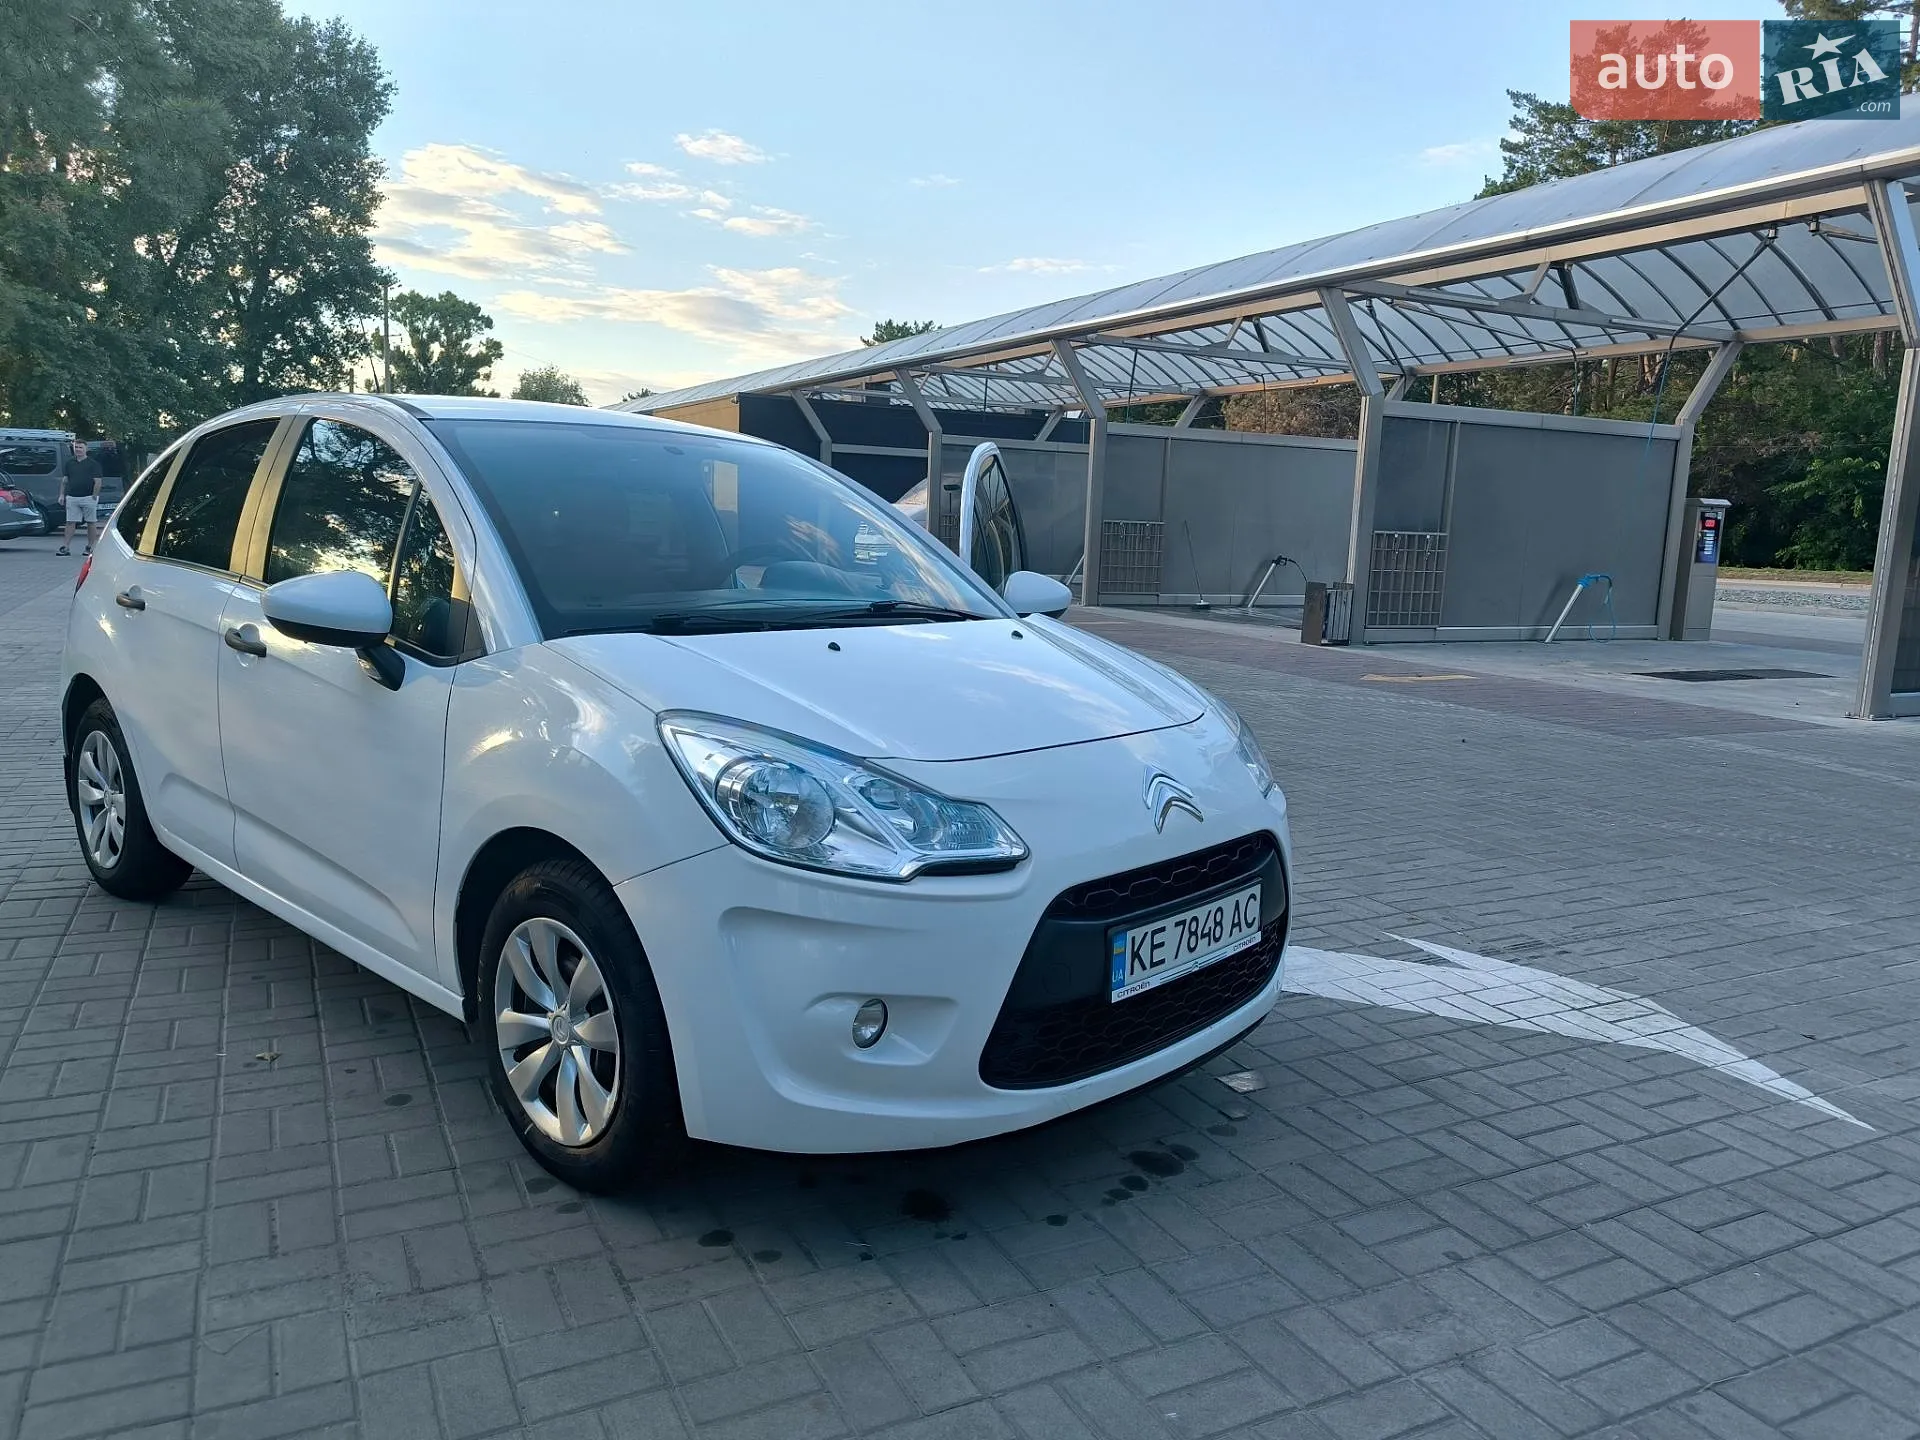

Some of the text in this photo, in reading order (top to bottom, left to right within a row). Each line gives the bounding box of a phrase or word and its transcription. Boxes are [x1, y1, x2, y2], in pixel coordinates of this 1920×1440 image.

[1130, 893, 1257, 976] KE 7848 AC
[1112, 968, 1124, 983] UA
